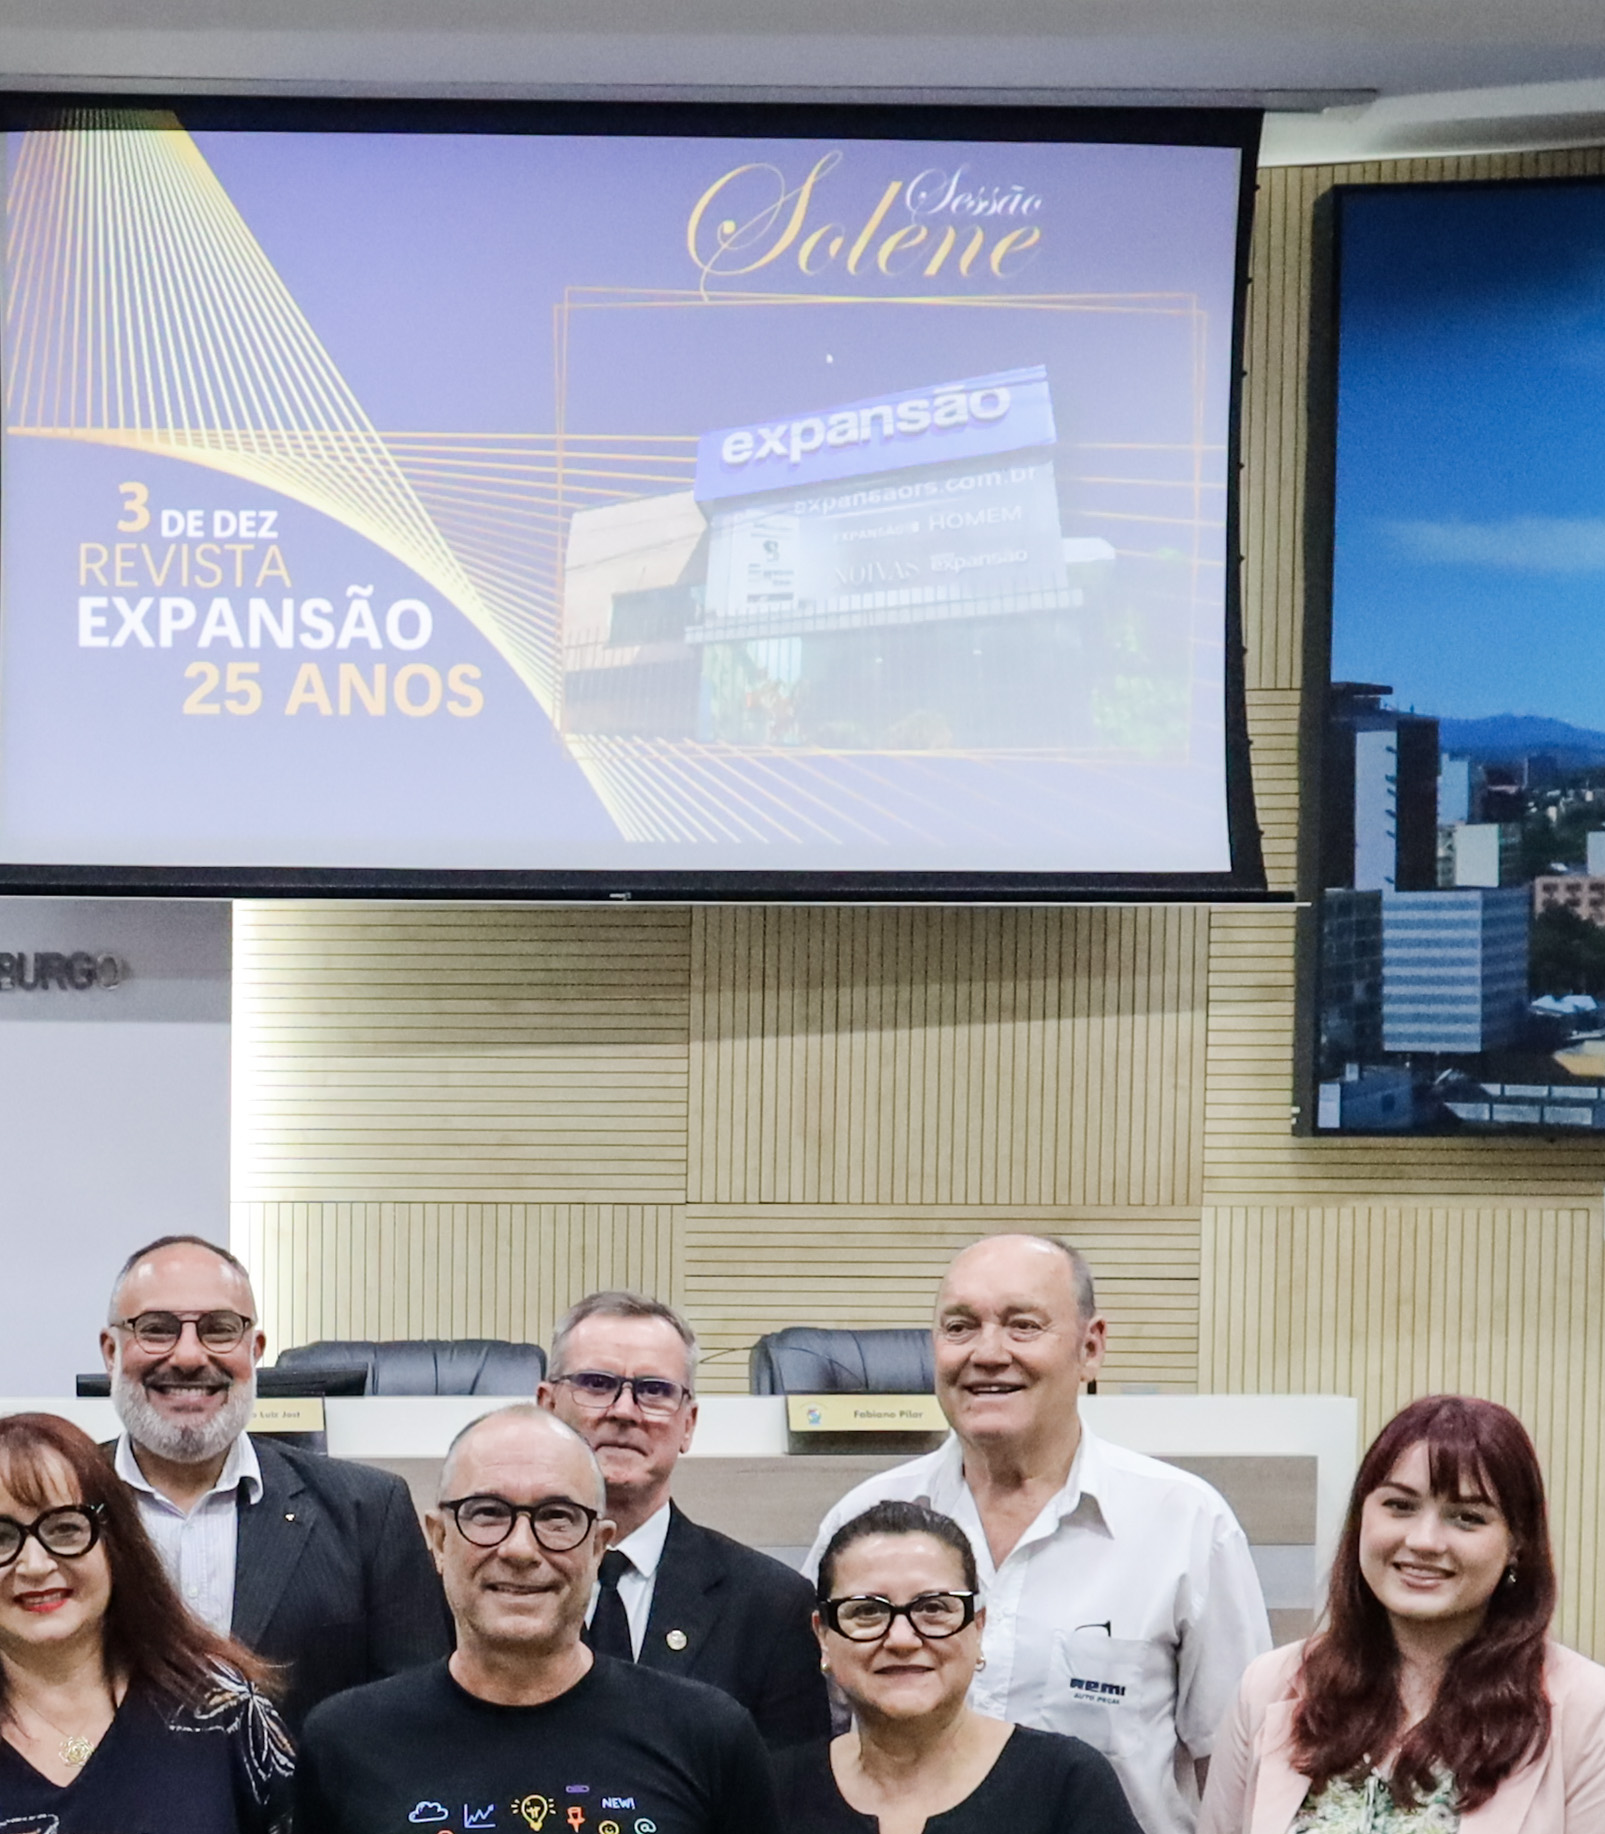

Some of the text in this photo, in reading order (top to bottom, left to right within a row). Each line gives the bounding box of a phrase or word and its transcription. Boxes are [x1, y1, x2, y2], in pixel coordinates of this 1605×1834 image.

[905, 163, 1042, 227] Sessão
[687, 150, 1043, 301] Solene
[721, 385, 1011, 466] expansão
[116, 481, 278, 539] 3 DE DEZ
[928, 505, 1023, 532] HOMEM
[79, 542, 293, 589] REVISTA
[77, 584, 434, 651] EXPANSÃO
[182, 661, 486, 718] 25 ANOS
[854, 1409, 924, 1419] Fabiano Pilar
[601, 1796, 636, 1810] NEW!
